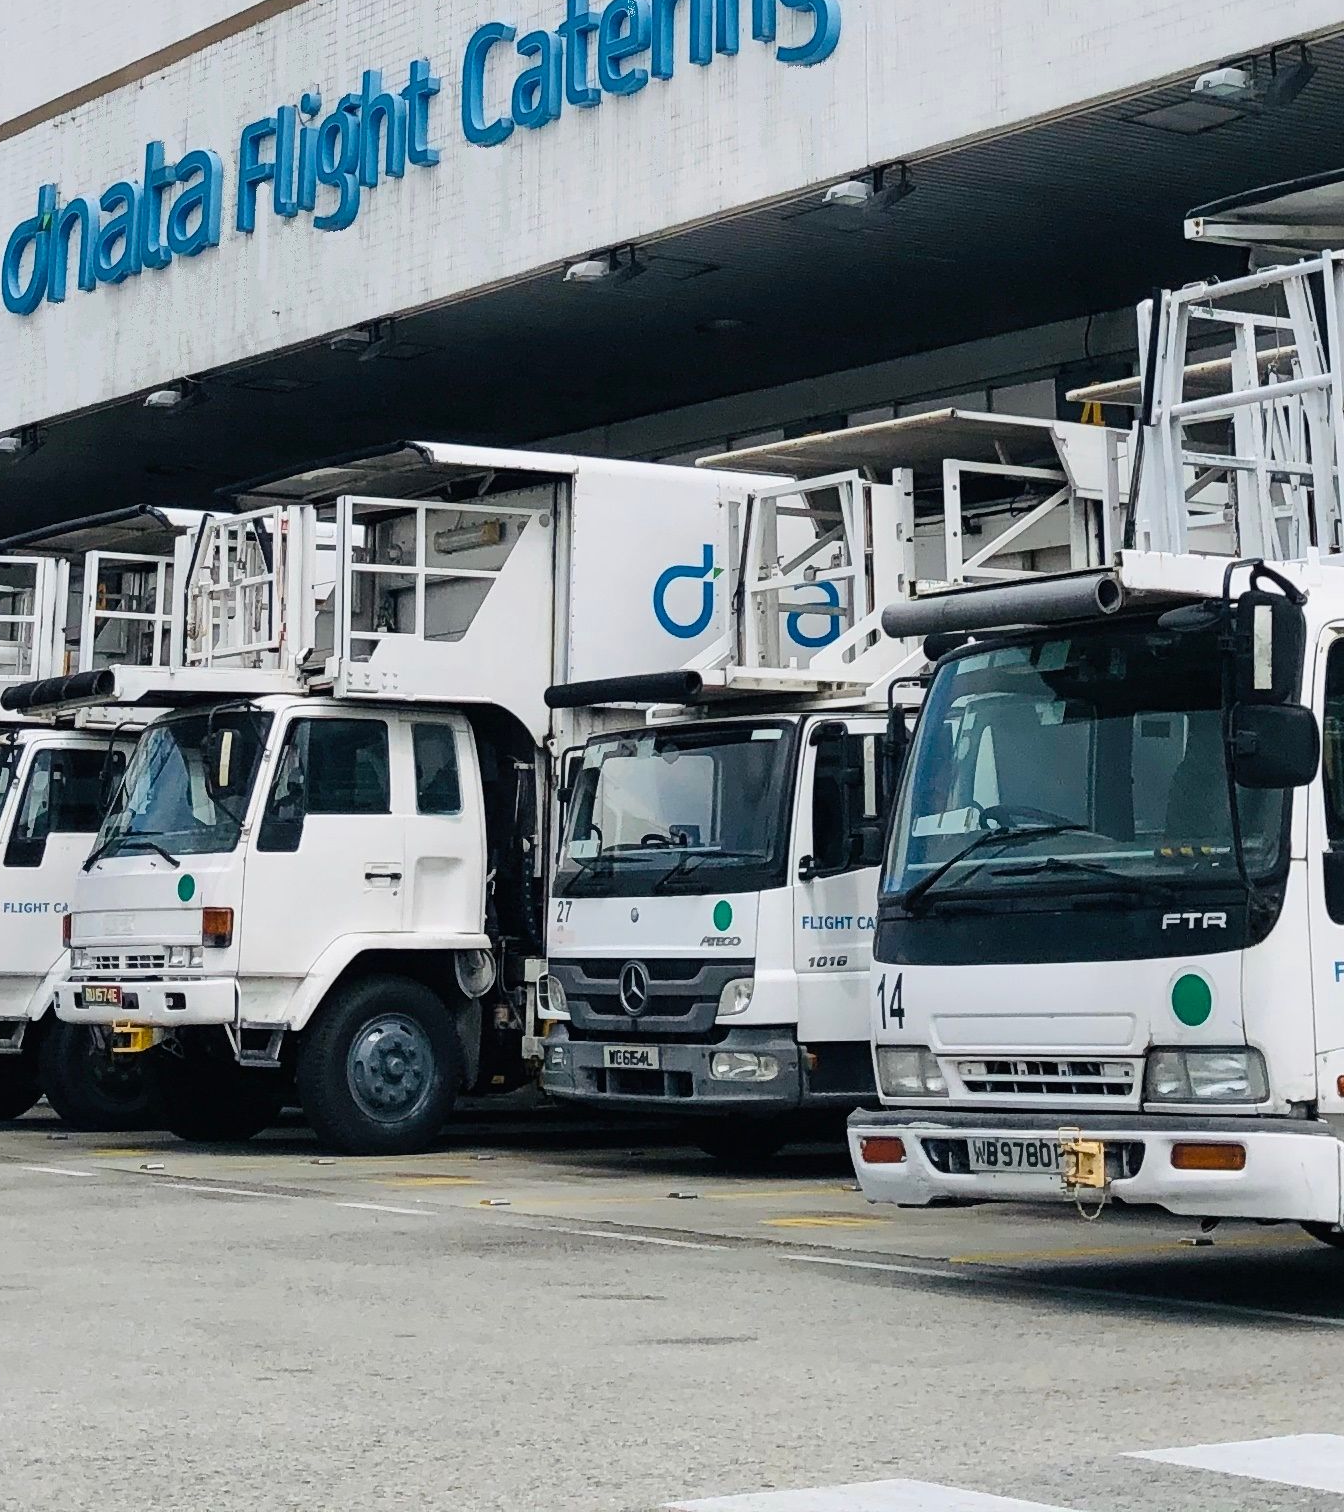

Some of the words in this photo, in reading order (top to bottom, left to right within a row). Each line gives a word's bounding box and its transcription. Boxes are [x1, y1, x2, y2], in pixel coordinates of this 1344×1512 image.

[2, 140, 223, 316] dnata
[236, 58, 442, 232] Flight
[3, 902, 50, 913] FLIGHT
[53, 902, 69, 913] CA
[556, 900, 573, 923] 27
[802, 915, 853, 929] FLIGHT
[857, 915, 878, 930] CA
[1161, 912, 1227, 929] FTR
[700, 936, 742, 947] ATEGO
[877, 972, 906, 1029] 14
